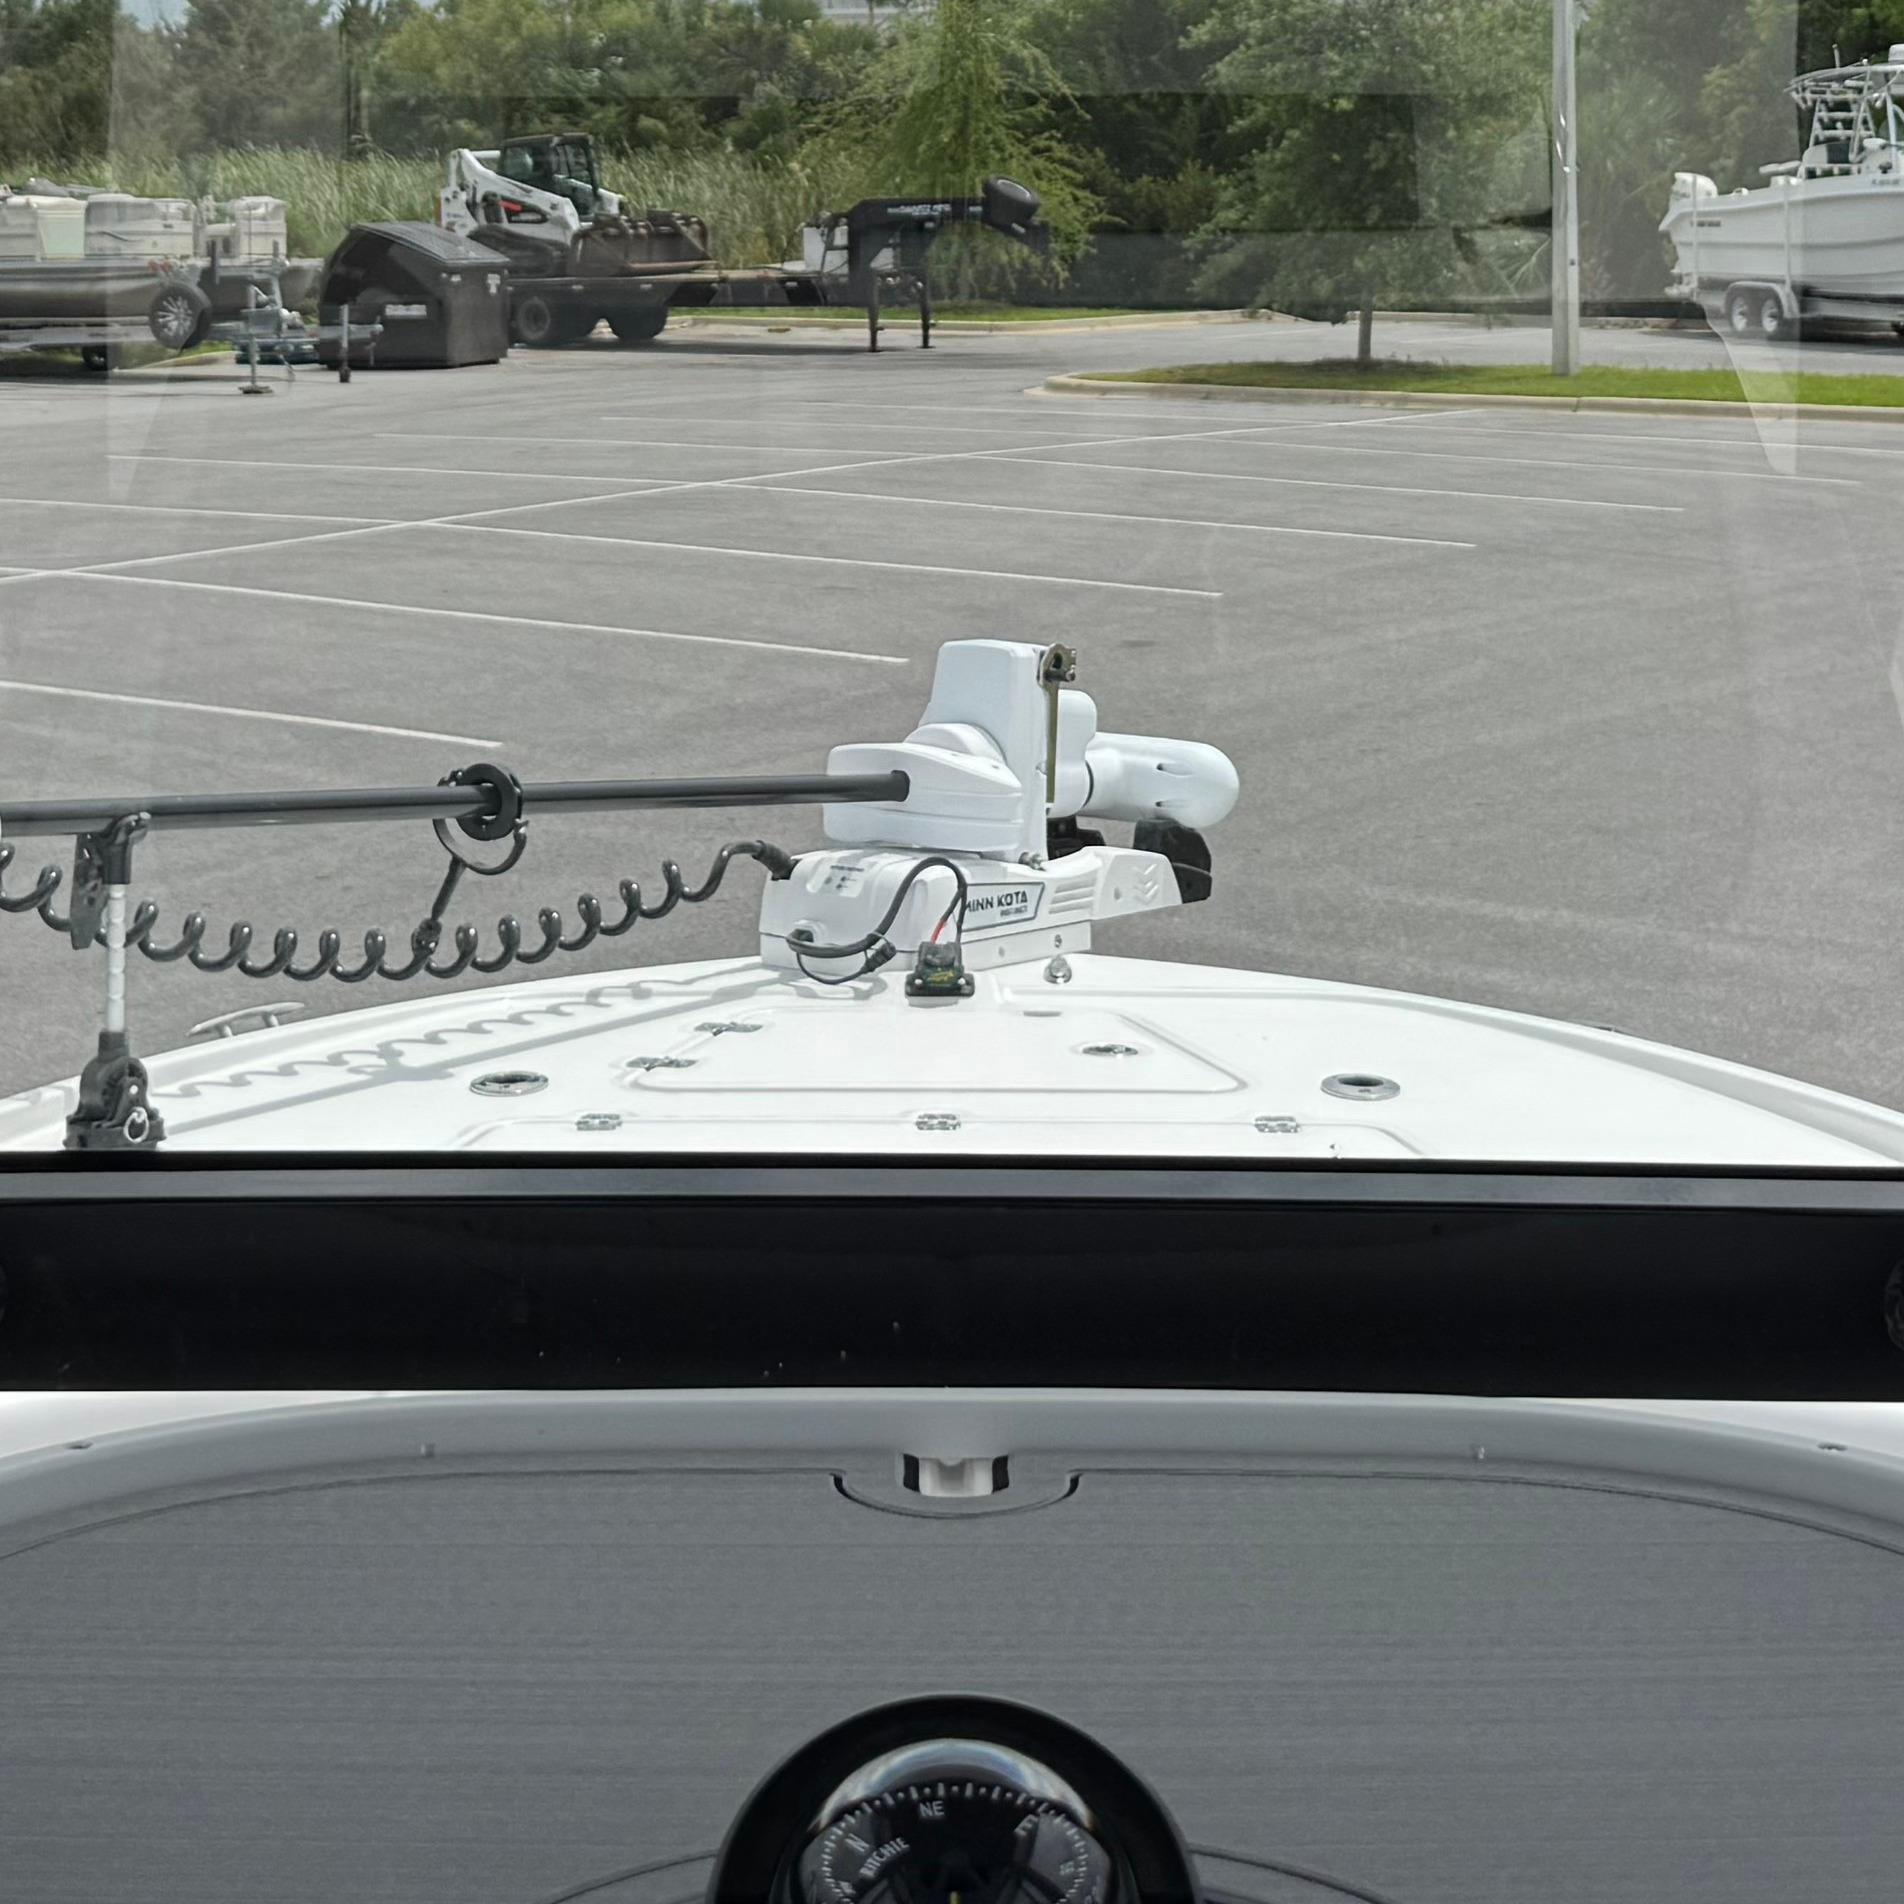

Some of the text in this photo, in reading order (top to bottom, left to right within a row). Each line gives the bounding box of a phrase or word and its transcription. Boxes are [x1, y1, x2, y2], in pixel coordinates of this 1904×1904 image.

[997, 890, 1028, 907] KOTA
[919, 1800, 946, 1817] NE
[1014, 1813, 1039, 1837] E
[845, 1833, 870, 1854] N
[858, 1836, 910, 1878] RITCHIE
